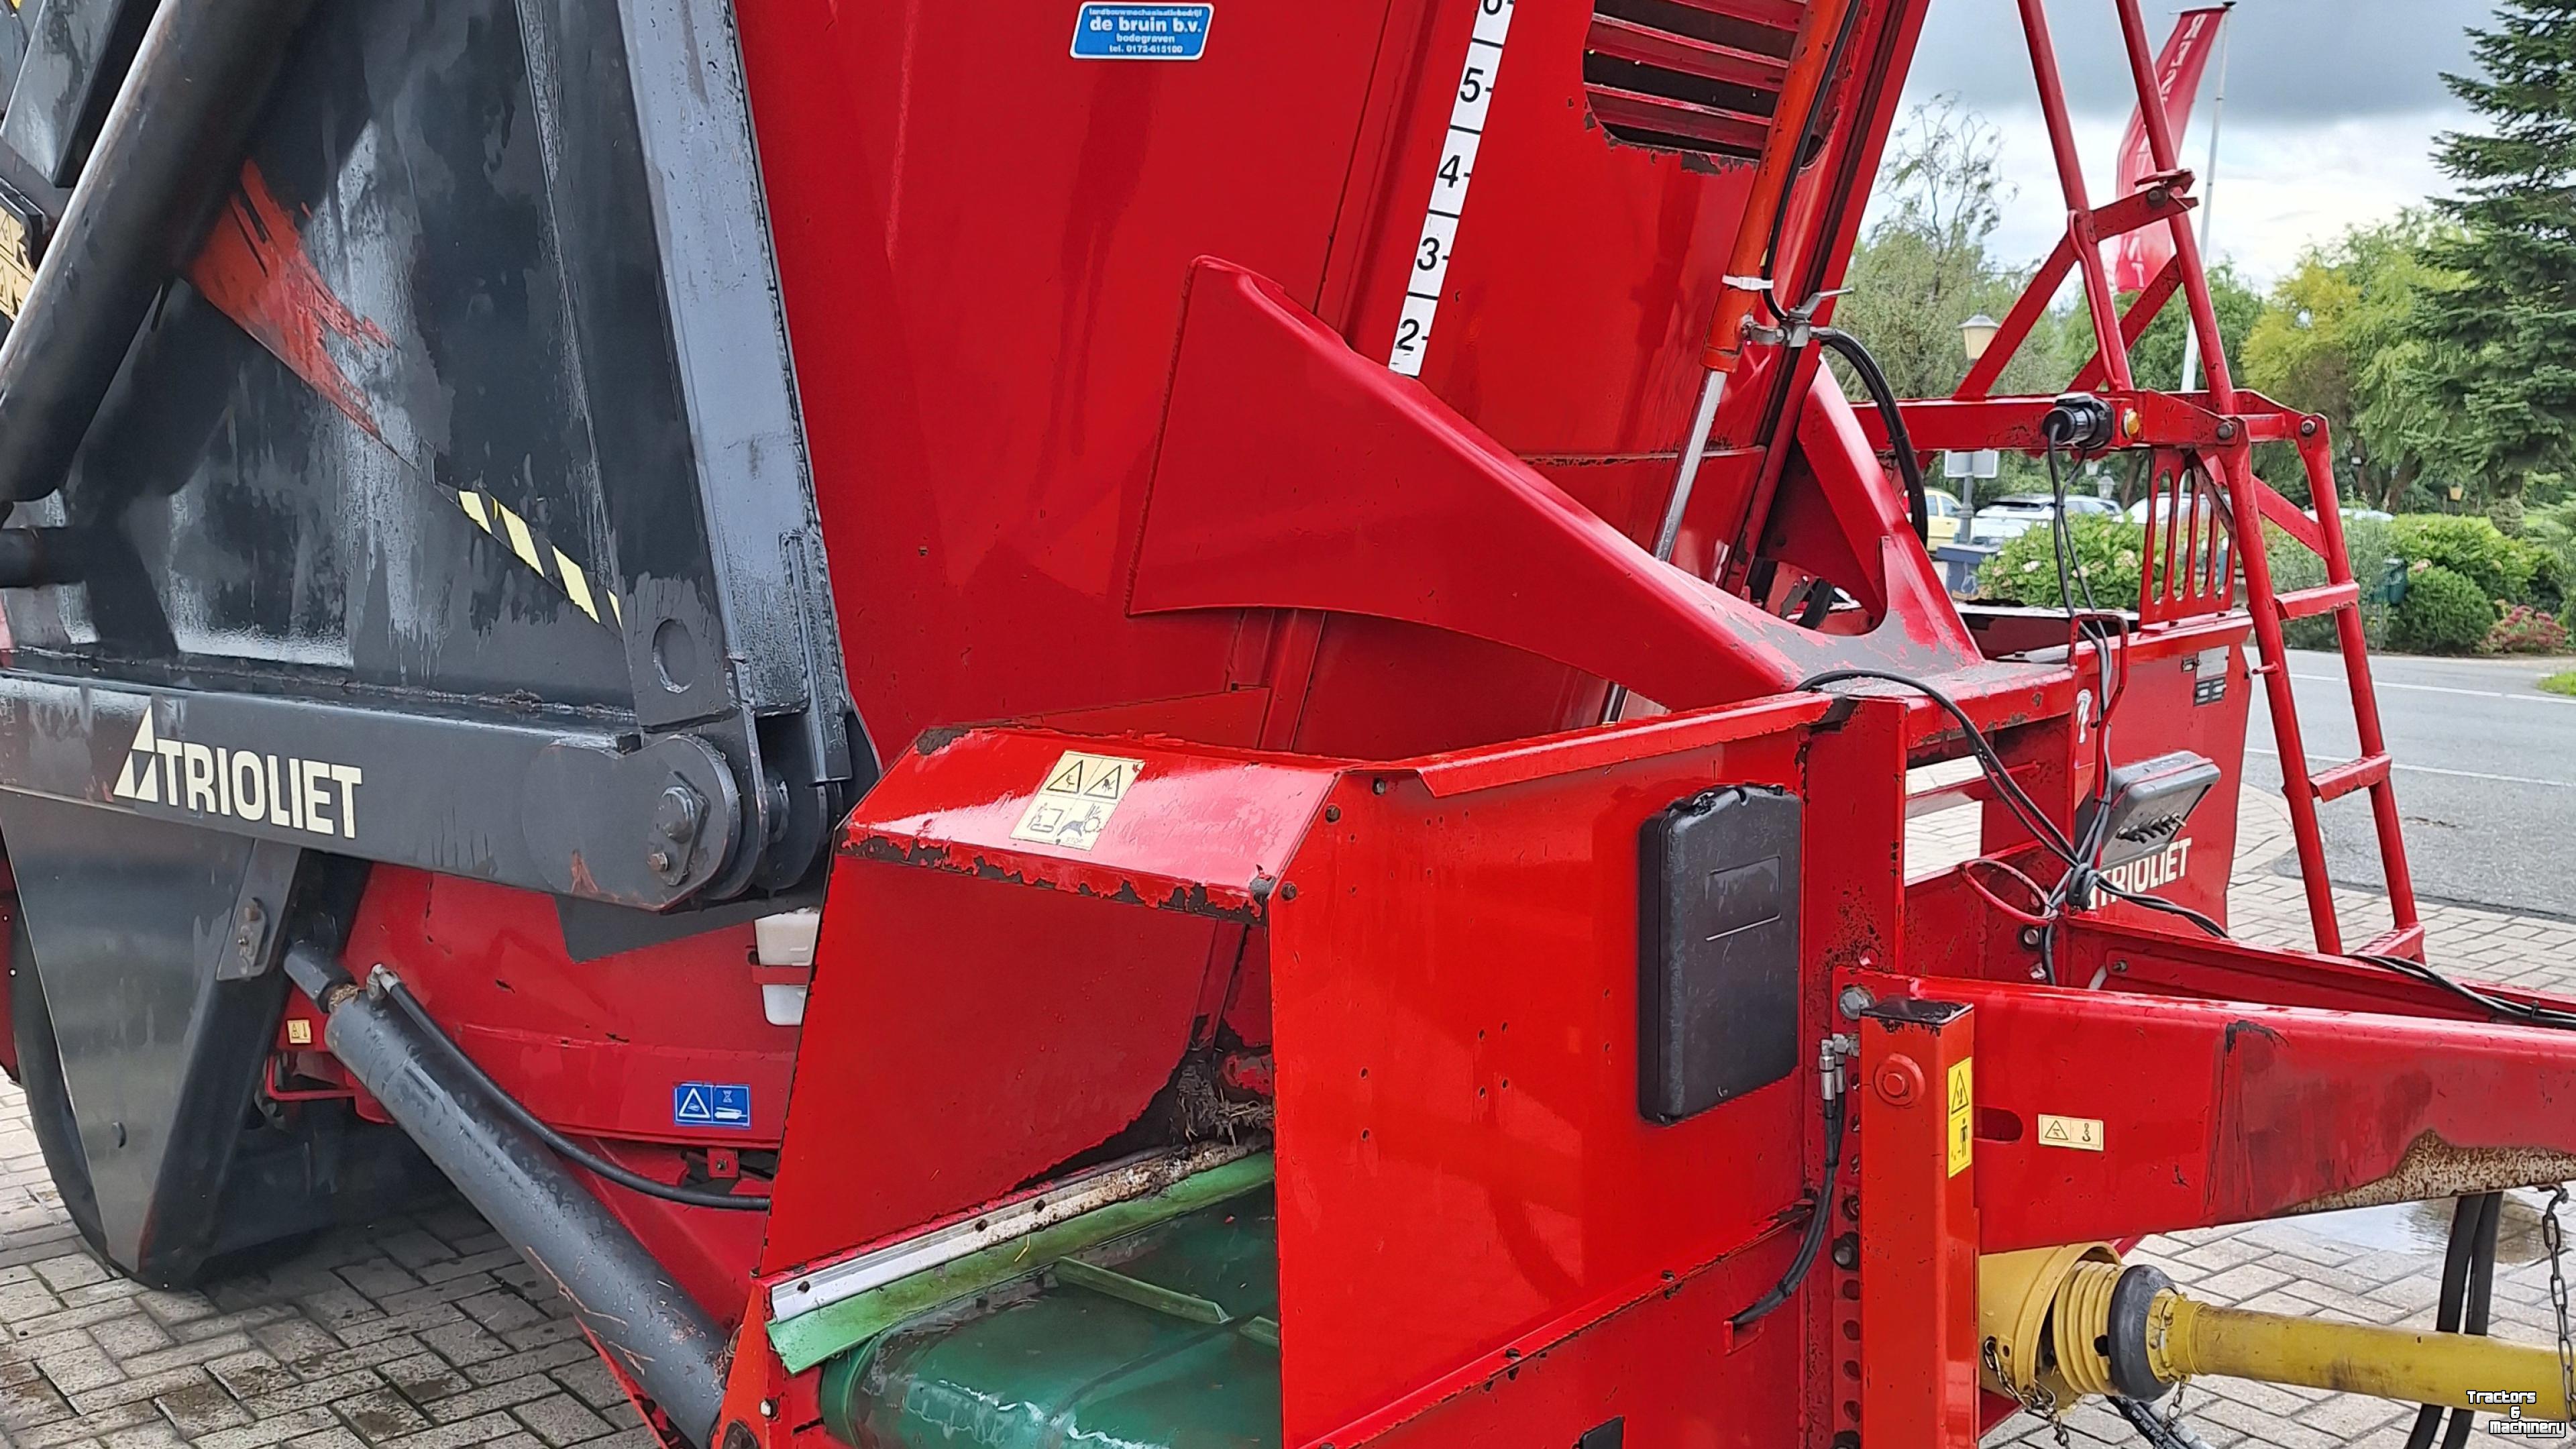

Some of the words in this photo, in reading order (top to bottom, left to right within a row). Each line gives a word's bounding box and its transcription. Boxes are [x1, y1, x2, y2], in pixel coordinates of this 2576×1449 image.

[1089, 17, 1113, 32] de
[1118, 17, 1167, 32] bruin
[1173, 17, 1201, 33] b.v.
[1116, 34, 1175, 44] bodegraven
[1109, 45, 1124, 53] tel.
[1460, 67, 1484, 103] 5
[1438, 154, 1461, 189] 4
[1417, 237, 1440, 271] 3
[1396, 318, 1420, 352] 2
[156, 738, 363, 839] TRIOLIET
[2099, 837, 2192, 906] TRIOLIET
